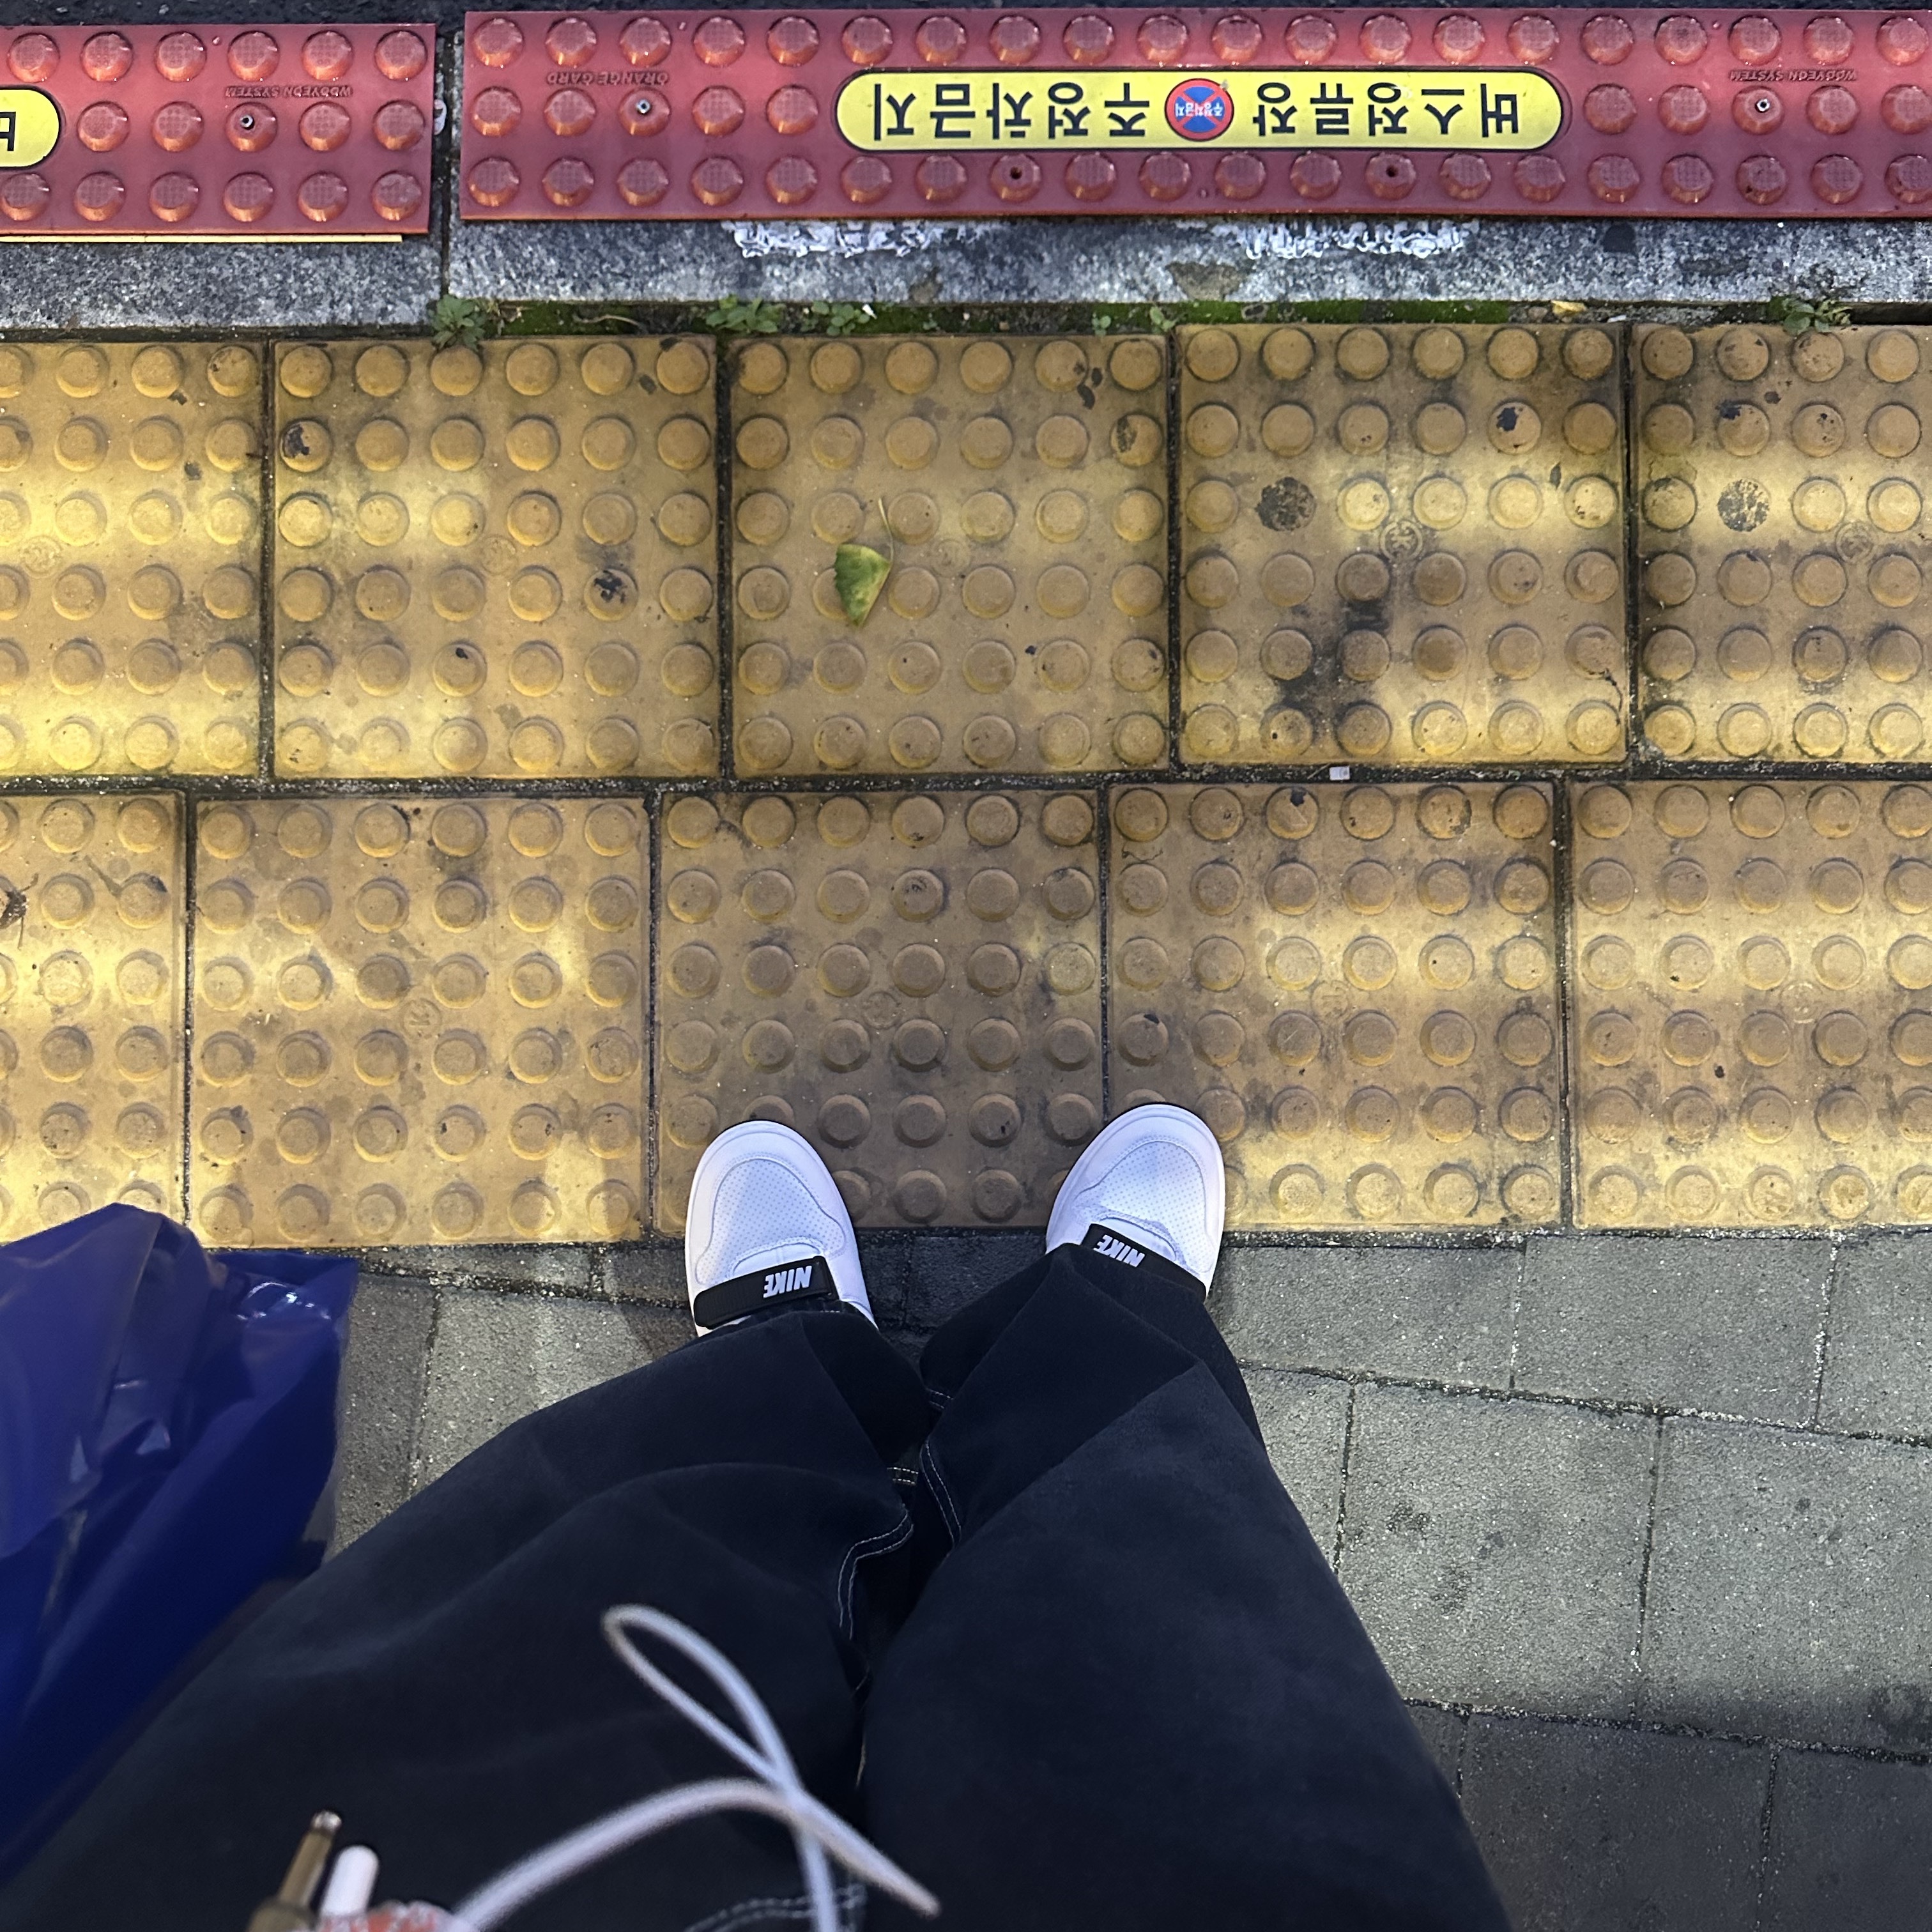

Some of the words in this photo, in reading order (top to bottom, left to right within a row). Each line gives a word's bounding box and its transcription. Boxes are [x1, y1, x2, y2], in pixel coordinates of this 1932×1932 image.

[547, 71, 594, 86] GARD
[597, 71, 670, 86] ORANGE
[1729, 69, 1784, 81] SYSTEM
[226, 85, 281, 98] SYSTEM
[873, 82, 1150, 141] 주정차금지
[1253, 82, 1519, 137] 버스정류장
[1093, 1234, 1146, 1268] NIKE
[763, 1266, 813, 1298] NIKE
